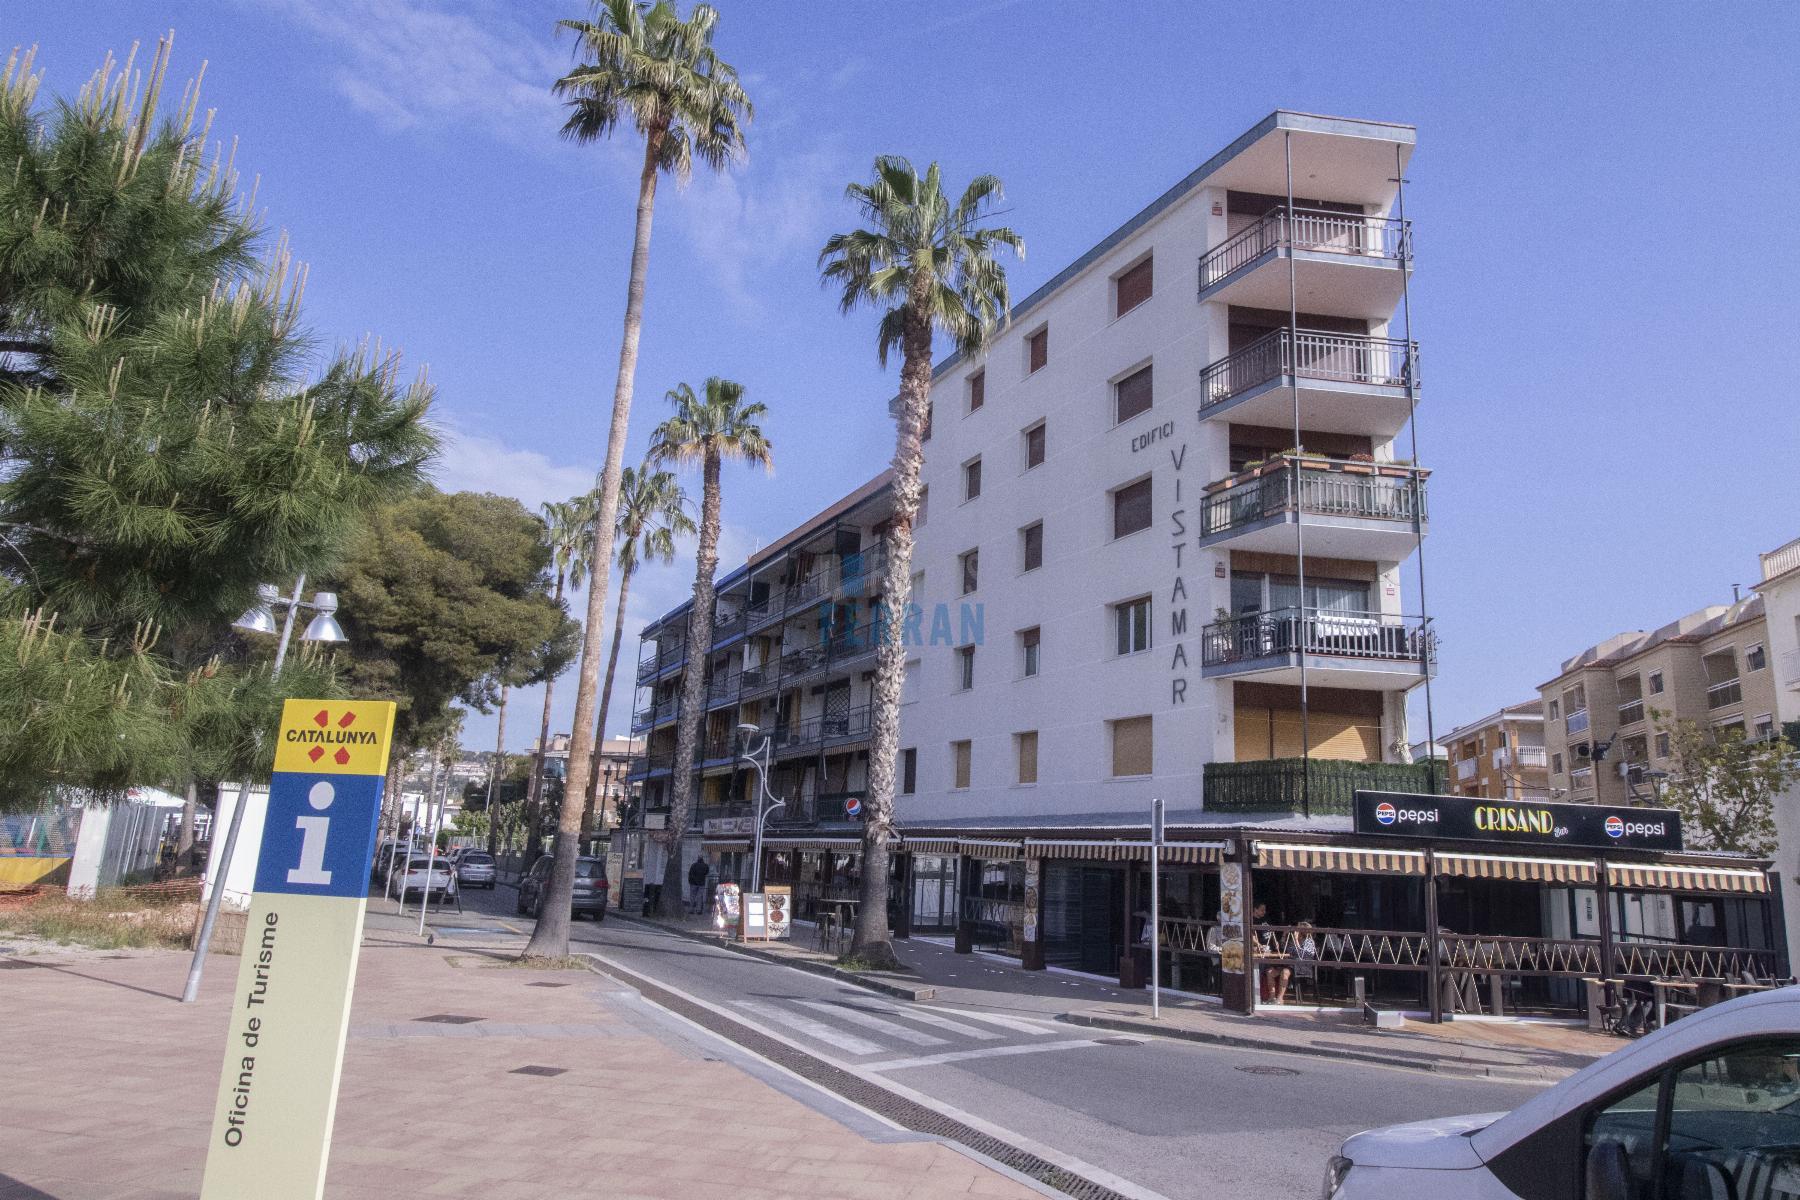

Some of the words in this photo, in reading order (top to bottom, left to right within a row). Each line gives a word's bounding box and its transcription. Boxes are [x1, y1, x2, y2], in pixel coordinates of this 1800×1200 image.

[1132, 420, 1174, 453] EDIFICI
[1170, 444, 1188, 705] VISTAMAR
[286, 729, 377, 745] CATALUNYA
[1398, 808, 1439, 825] pepsi
[1474, 806, 1554, 834] CRISAND
[1625, 822, 1665, 838] pepsi
[247, 912, 278, 1009] Turisme
[242, 1017, 261, 1048] de
[225, 1056, 255, 1147] Oficina
